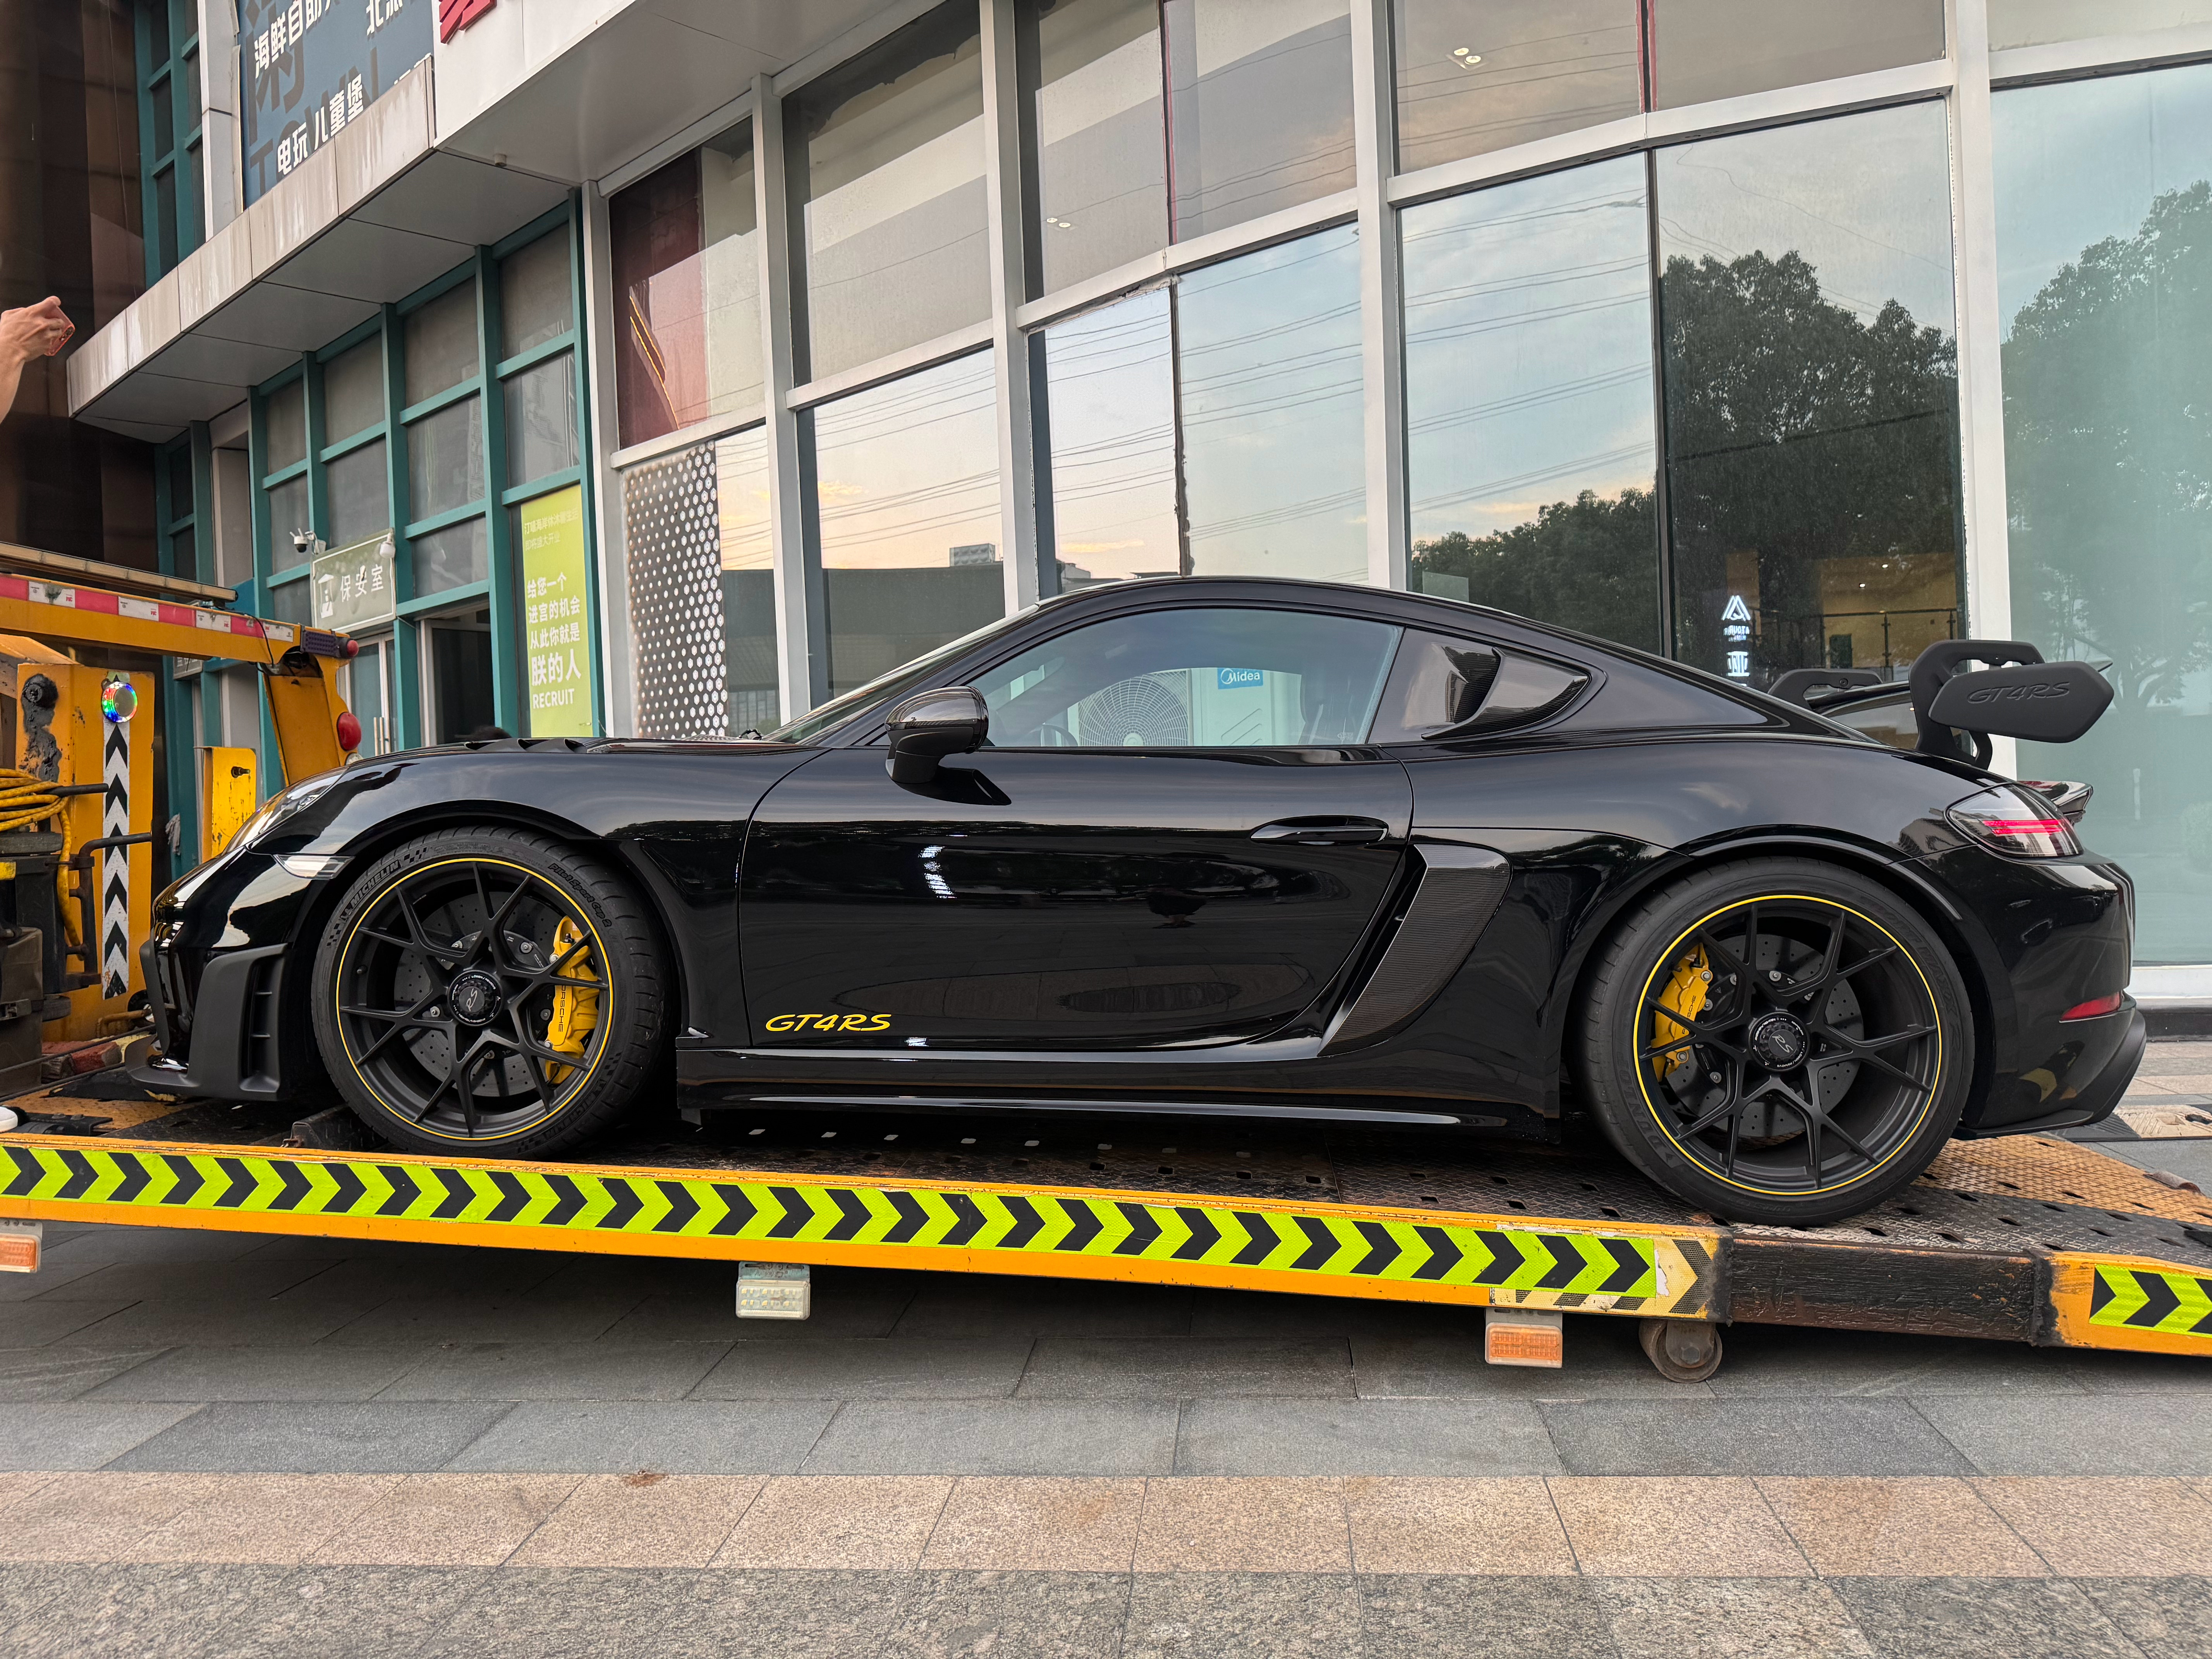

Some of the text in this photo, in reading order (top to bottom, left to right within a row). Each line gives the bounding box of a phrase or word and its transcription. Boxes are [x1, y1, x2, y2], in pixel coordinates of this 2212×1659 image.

[254, 0, 333, 79] 海鲜自助
[277, 73, 364, 175] 电玩 儿童堡
[340, 564, 384, 603] 保安室
[527, 571, 567, 598] 给您一个
[529, 595, 580, 624] 进宫的机会
[530, 622, 580, 649] 从此你就是
[531, 648, 582, 686] 朕的人
[1221, 668, 1260, 684] Midea
[533, 688, 575, 709] RECRUIT
[350, 859, 400, 908] MICHELIN
[569, 879, 595, 903] Sport
[592, 902, 605, 919] Cup
[602, 919, 612, 927] 2
[466, 988, 477, 1012] RS
[1682, 995, 1696, 1034] PSCHE
[1772, 1034, 1793, 1053] RS
[1616, 1051, 1667, 1149] DUNLOP
